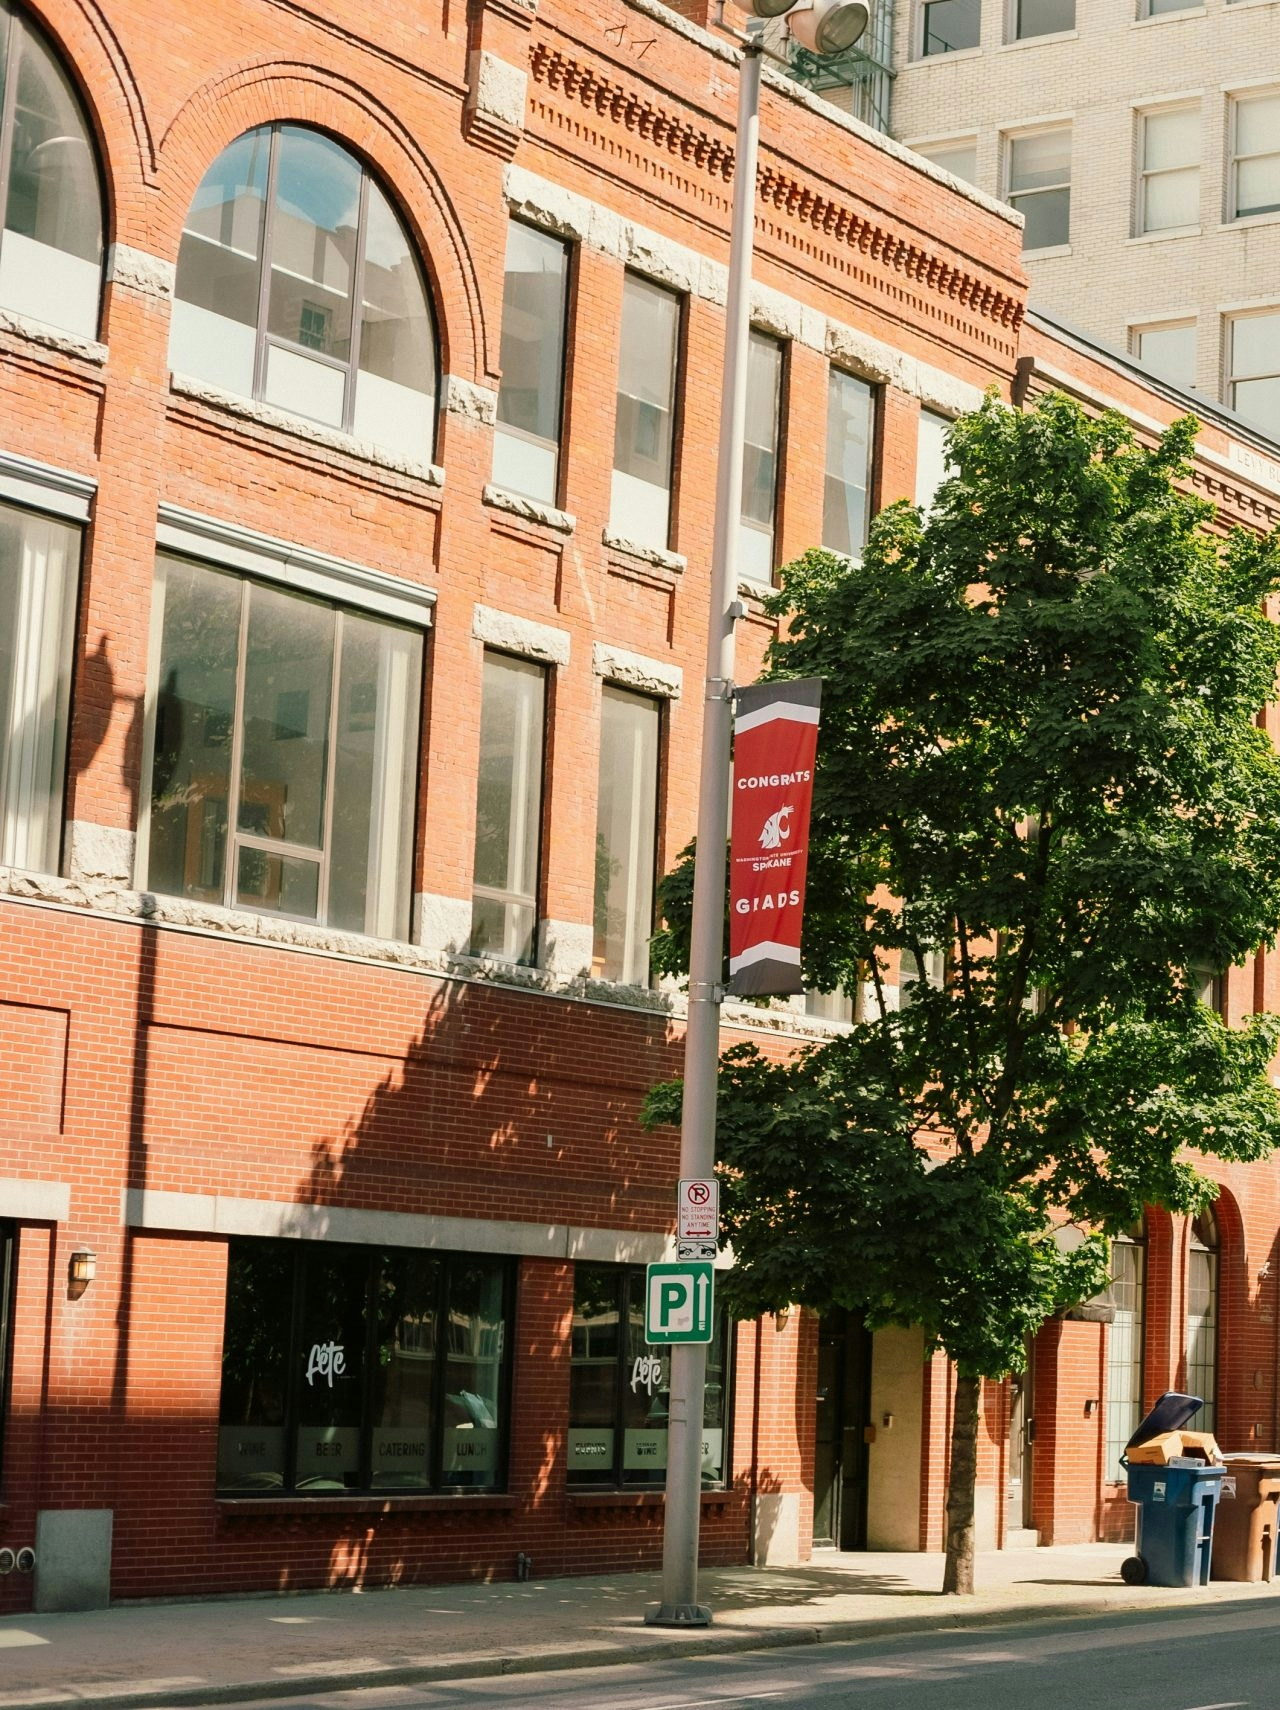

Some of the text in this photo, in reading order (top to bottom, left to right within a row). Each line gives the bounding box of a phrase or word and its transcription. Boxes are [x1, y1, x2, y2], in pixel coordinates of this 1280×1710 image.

[737, 770, 810, 789] CONGRATS
[752, 857, 792, 872] SPKANE
[660, 1282, 687, 1327] P
[316, 1442, 342, 1457] BEER
[379, 1442, 425, 1457] CATERING
[457, 1442, 487, 1456] LUNCH
